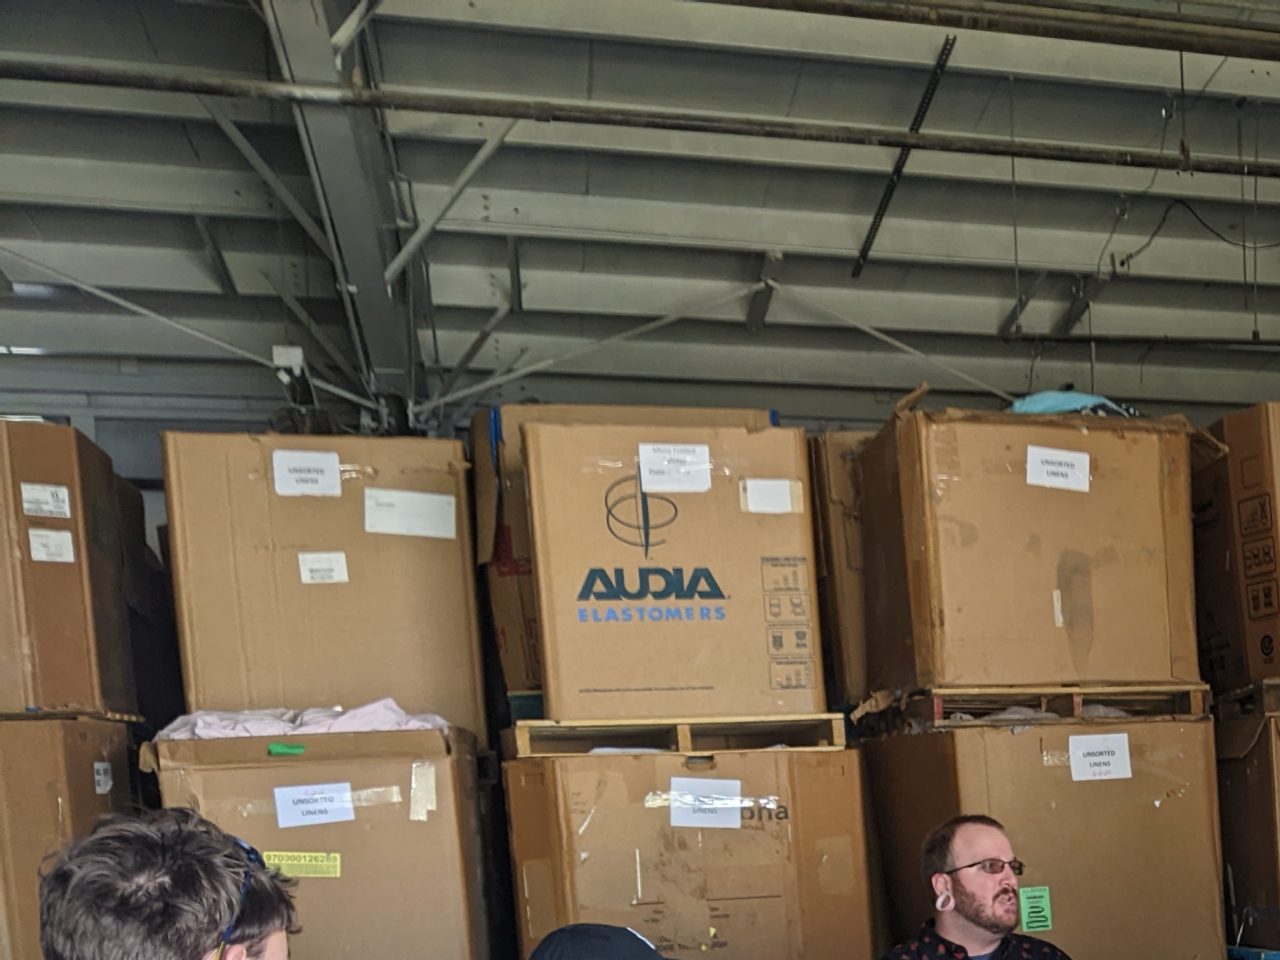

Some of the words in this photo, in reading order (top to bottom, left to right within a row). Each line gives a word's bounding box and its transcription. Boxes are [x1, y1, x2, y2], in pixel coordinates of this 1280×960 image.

[1046, 470, 1069, 480] LINENS
[577, 567, 726, 602] AUDIA
[577, 606, 727, 622] ELASTOMERS
[1082, 750, 1116, 758] UNSORTED
[692, 807, 718, 815] LINENS
